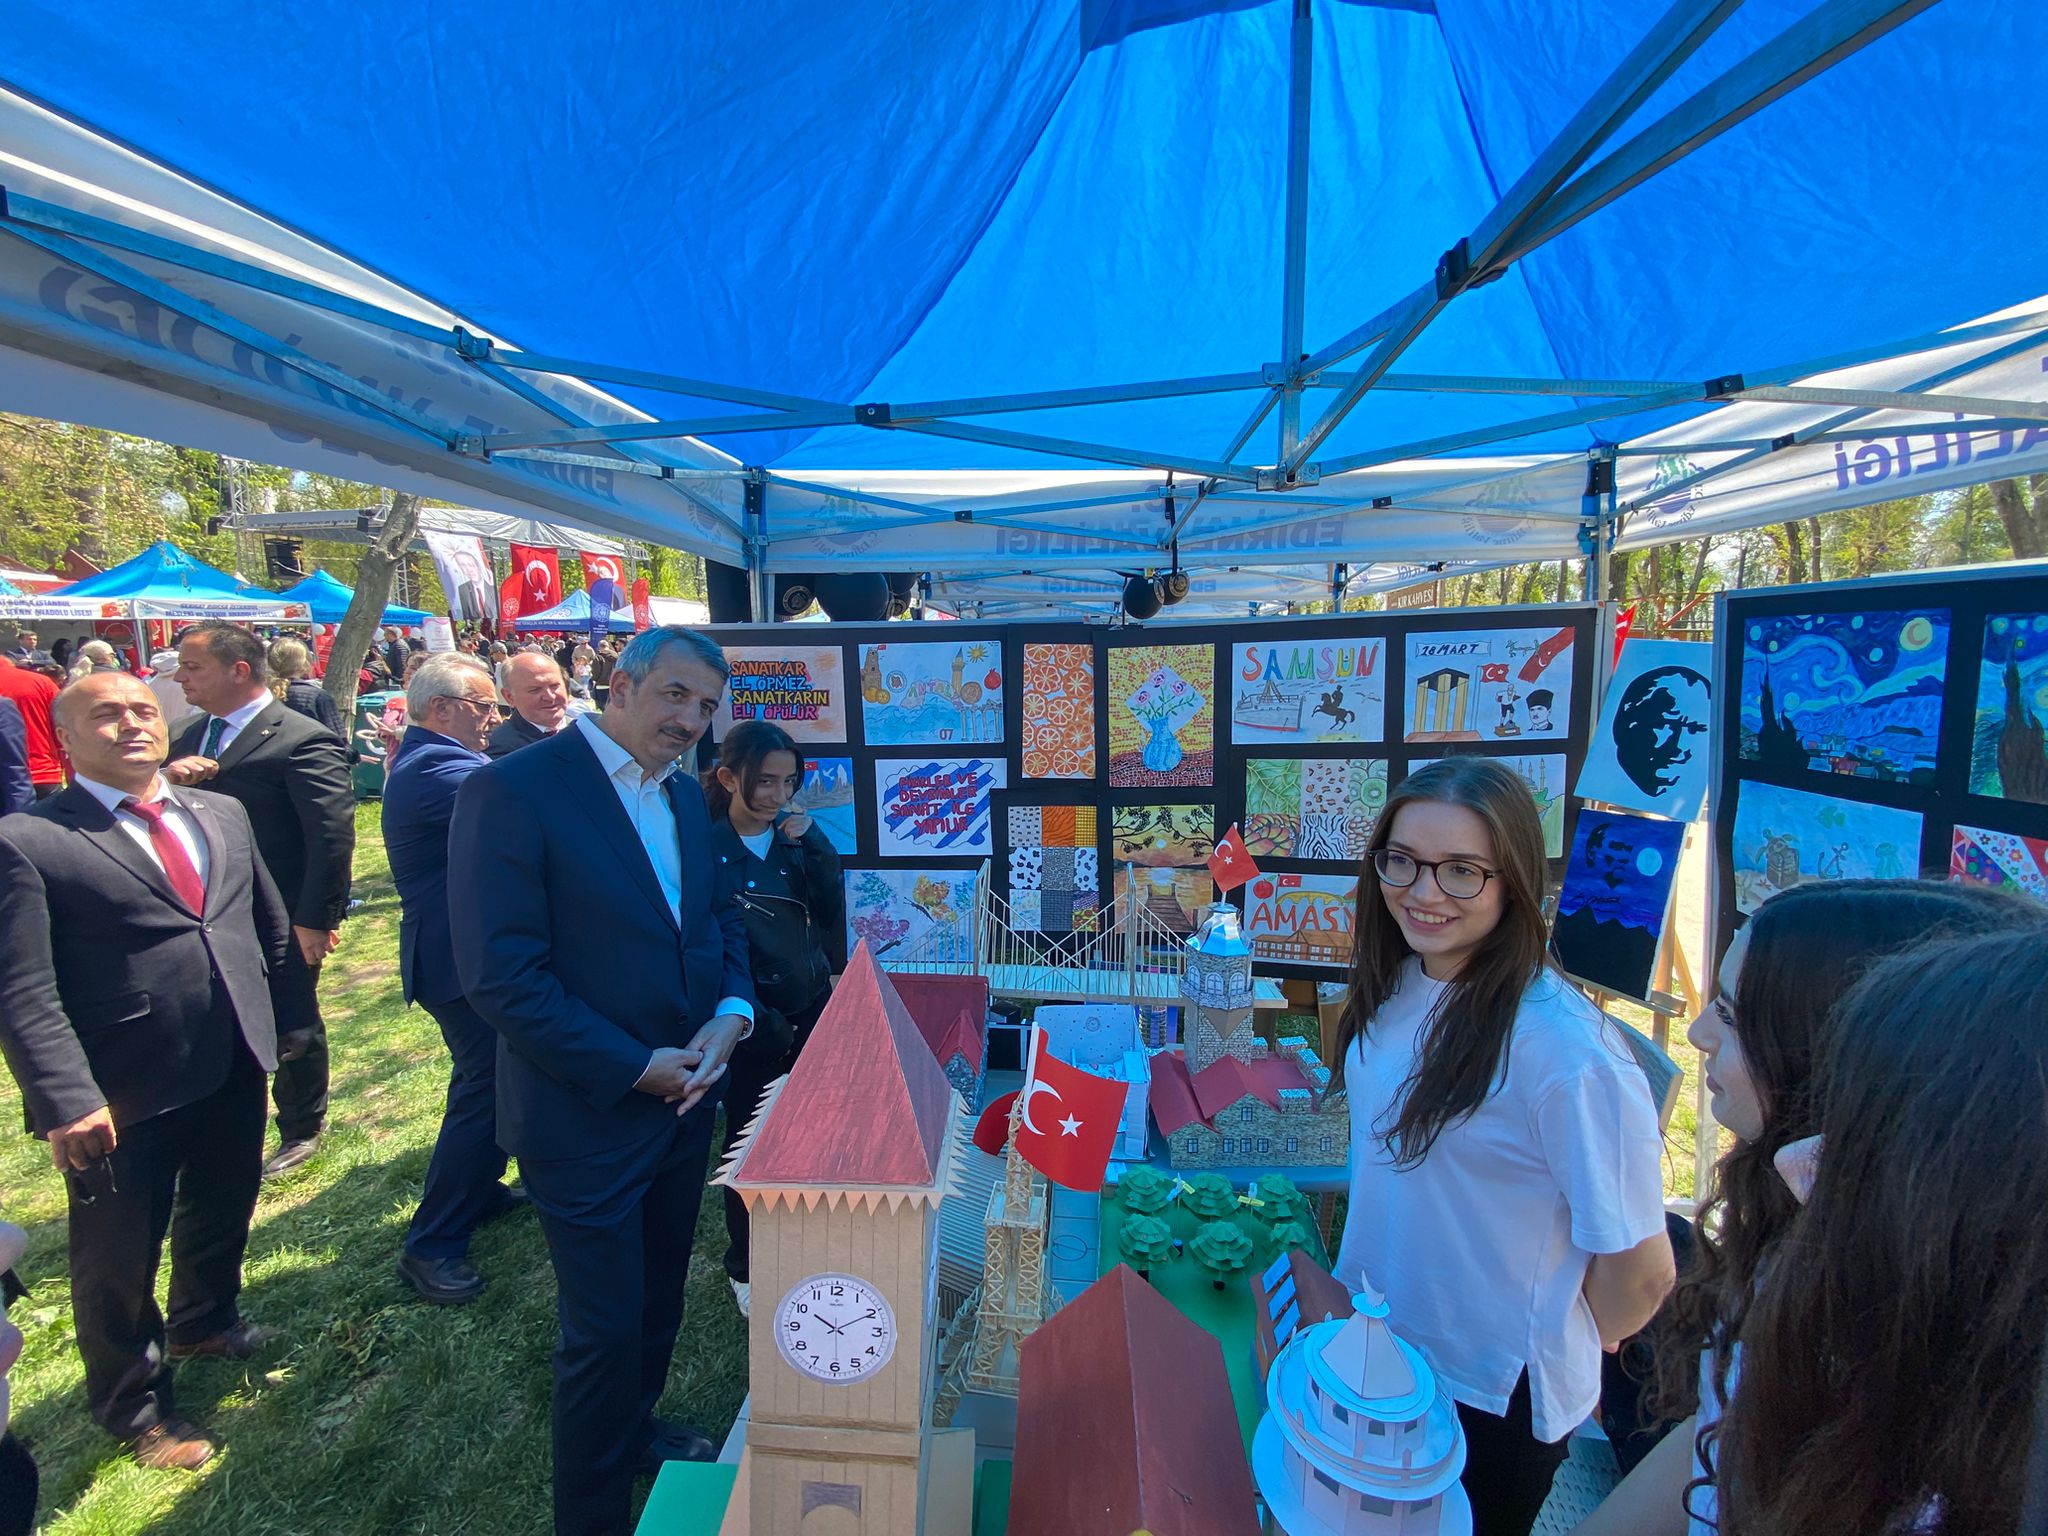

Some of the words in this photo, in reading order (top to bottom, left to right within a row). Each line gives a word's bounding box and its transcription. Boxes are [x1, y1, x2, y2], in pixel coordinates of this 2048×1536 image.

[730, 661, 806, 676] SANATKAR
[1241, 644, 1379, 682] SAMSUN
[730, 676, 751, 690] EL
[732, 689, 829, 706] SANATKARIN
[764, 704, 818, 721] ÖPÜLÜR
[939, 728, 954, 741] 07
[956, 771, 978, 785] VE
[890, 802, 943, 819] SANAT
[1249, 902, 1357, 932] AMASY
[812, 1290, 821, 1300] 11
[830, 1285, 844, 1296] 12
[796, 1303, 808, 1314] 10
[866, 1308, 877, 1319] 2
[789, 1321, 801, 1332] 9
[871, 1327, 883, 1338] 3
[795, 1340, 807, 1351] 8
[865, 1346, 876, 1356] 4
[810, 1355, 820, 1366] 7
[850, 1358, 861, 1368] 5
[829, 1362, 841, 1372] 6
